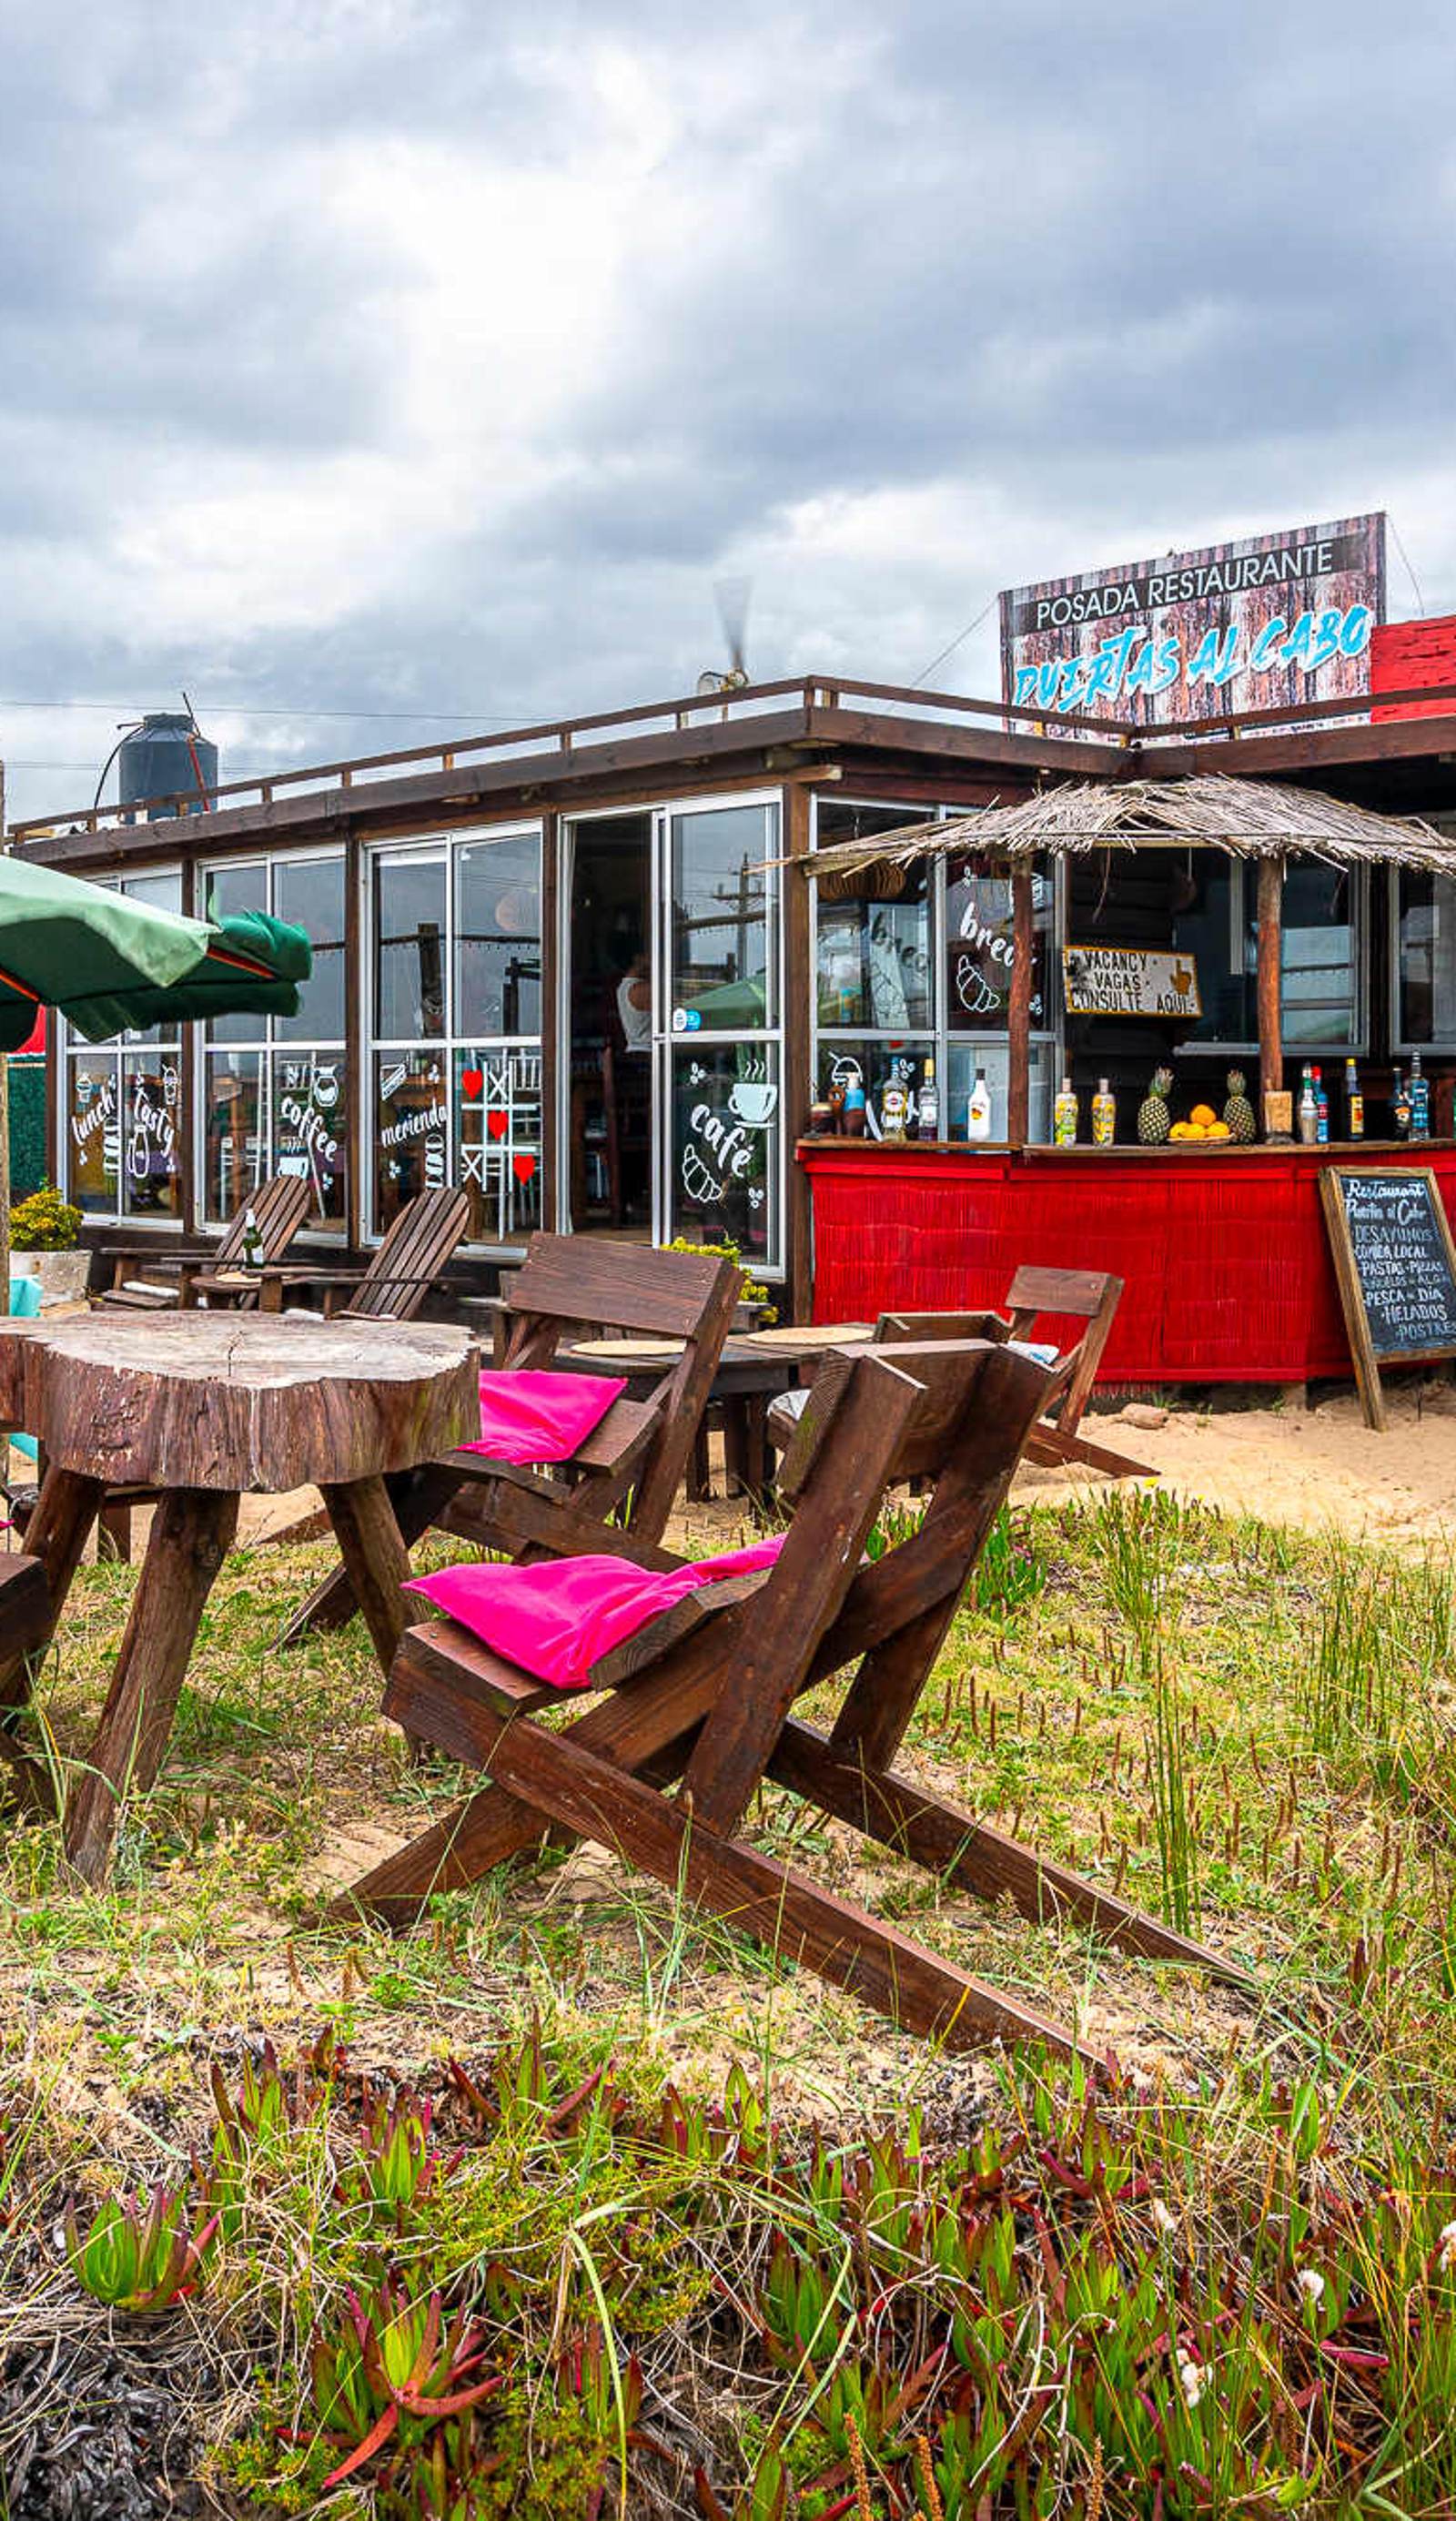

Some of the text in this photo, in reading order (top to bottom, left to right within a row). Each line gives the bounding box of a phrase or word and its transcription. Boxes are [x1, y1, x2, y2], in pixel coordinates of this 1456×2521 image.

[1036, 542, 1333, 630] POSADA RESTAURANTE
[1012, 602, 1371, 713] PUERTAS AL CABO
[1084, 951, 1148, 972] VACANCY
[1094, 971, 1142, 992] VAGAS
[1072, 988, 1143, 1012] CONSULTE
[72, 1086, 116, 1147] lunch
[135, 1087, 175, 1158] tasty
[281, 1096, 338, 1162] coffee
[381, 1096, 448, 1149] merienda
[691, 1103, 754, 1179] café
[1394, 1244, 1427, 1259] LOCAL
[1366, 1289, 1405, 1307] PESCA
[1384, 1304, 1448, 1325] HELADOS
